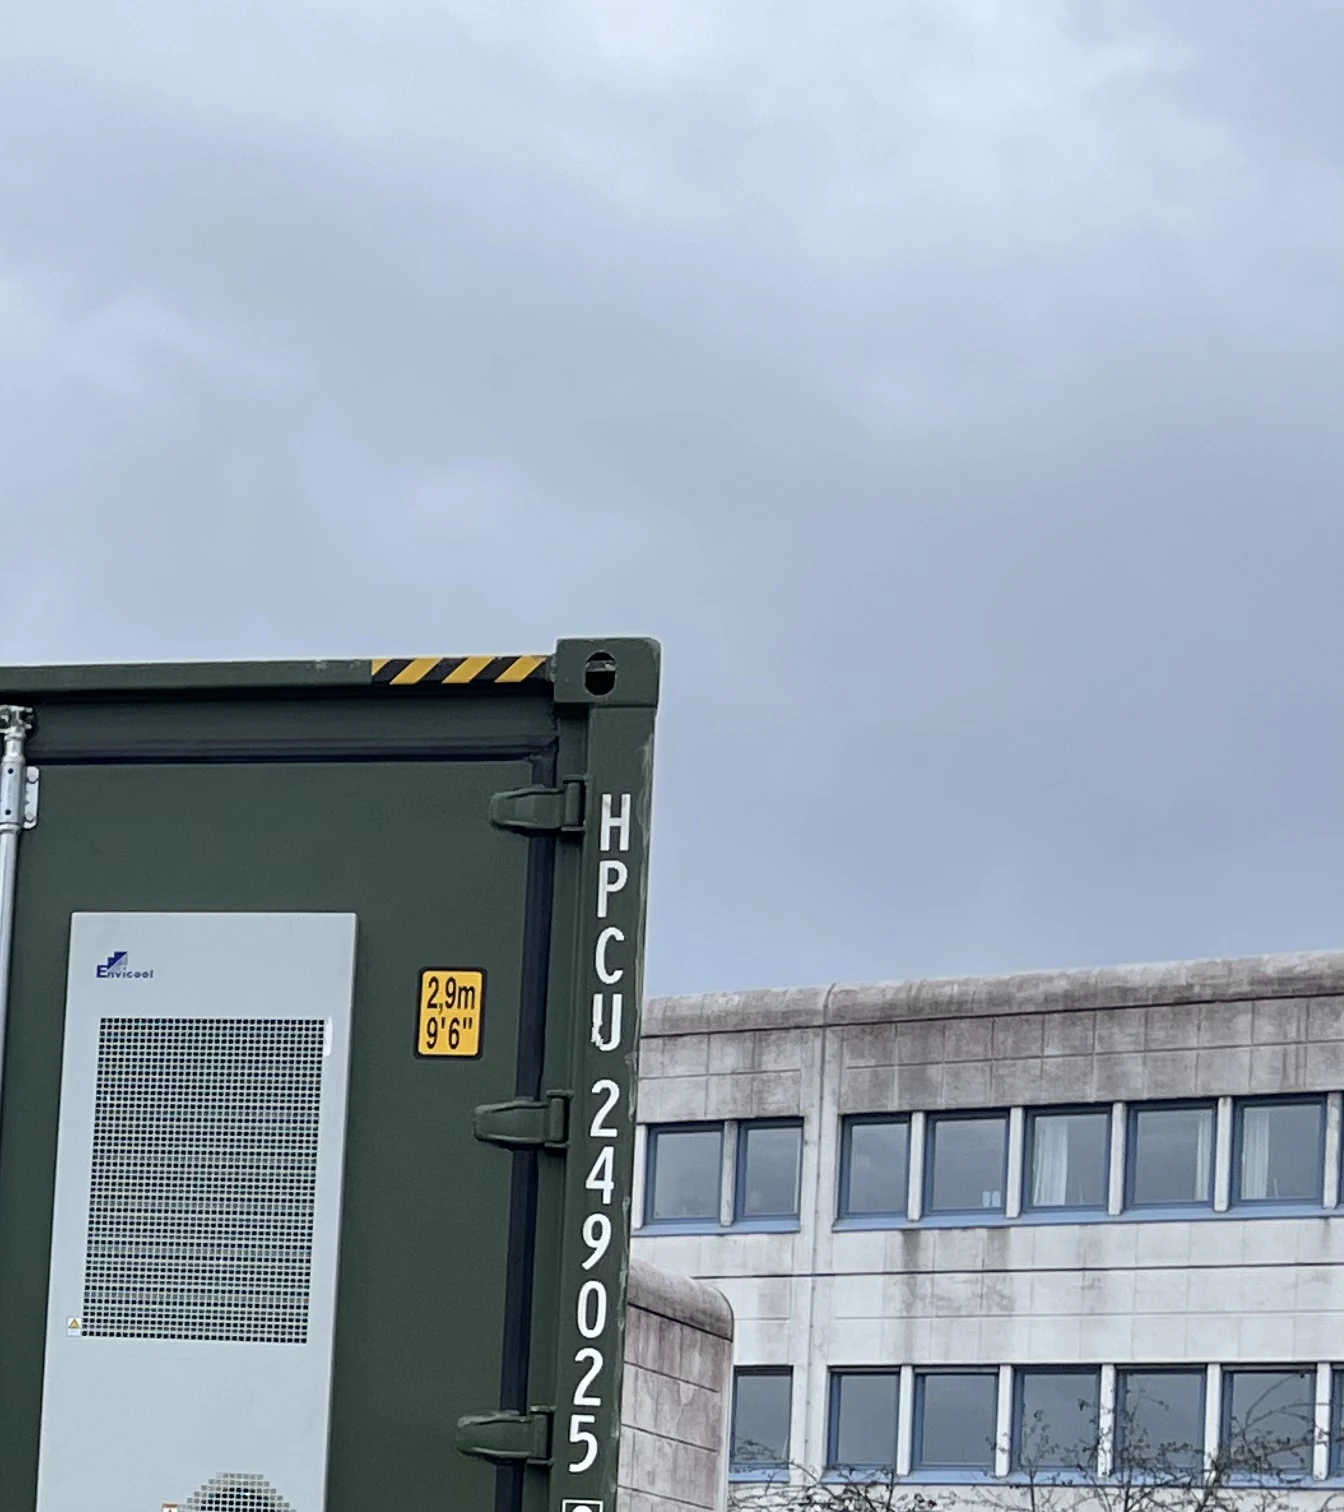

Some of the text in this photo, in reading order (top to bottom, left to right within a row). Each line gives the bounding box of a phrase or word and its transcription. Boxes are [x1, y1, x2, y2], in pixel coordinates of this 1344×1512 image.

[96, 965, 154, 978] Envicool
[427, 976, 475, 1015] 2,9m
[591, 793, 631, 1051] HPCU
[568, 1079, 620, 1473] 249025
